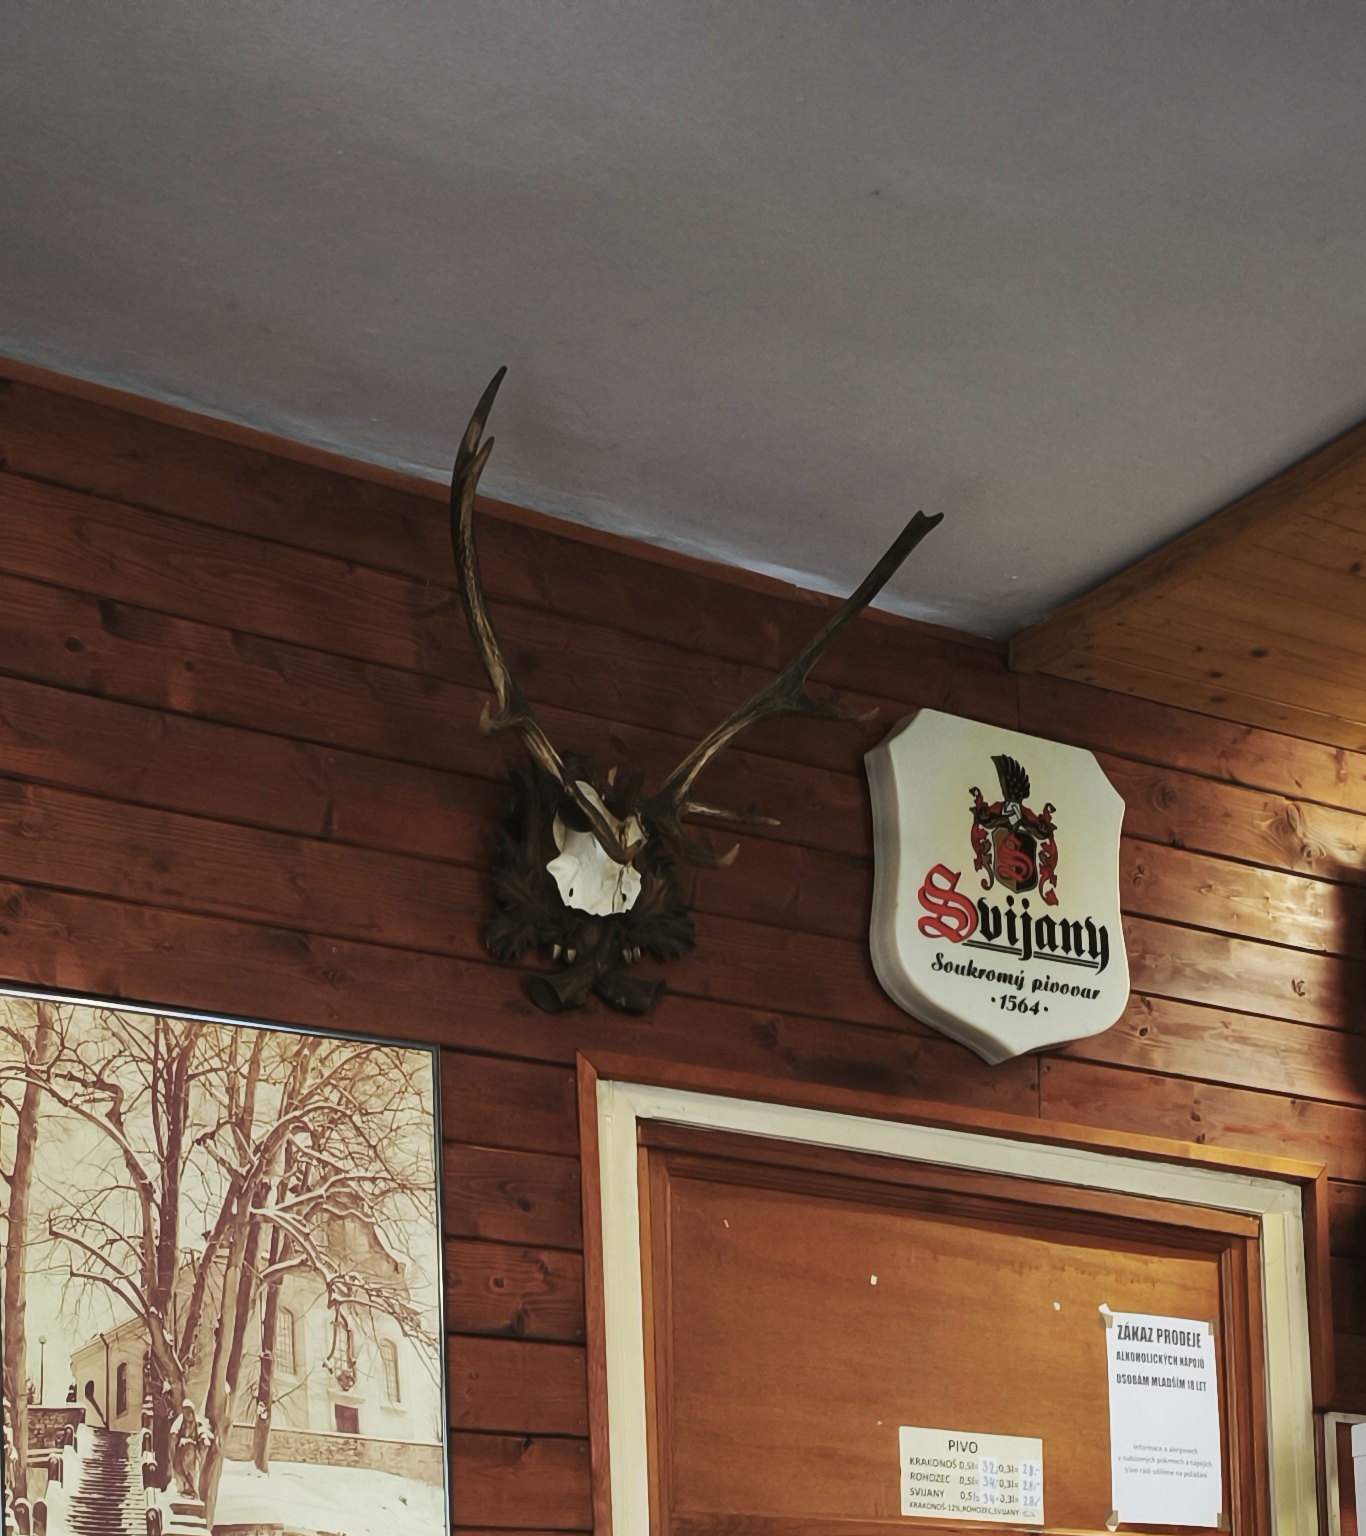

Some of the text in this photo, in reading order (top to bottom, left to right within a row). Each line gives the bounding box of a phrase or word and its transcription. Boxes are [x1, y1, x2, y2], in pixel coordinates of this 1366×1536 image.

[917, 863, 1110, 975] Svijany
[931, 952, 1101, 1000] Soukromý pivovar
[1117, 1322, 1202, 1348] ZÁKAZ PRODEJE
[1116, 1350, 1178, 1366] ALKOHOLICKÝCH
[1116, 1373, 1150, 1387] OSOBÁM
[1151, 1376, 1186, 1390] MLADŠÍM
[1196, 1381, 1207, 1392] LET
[948, 1440, 978, 1454] PIVO
[910, 1457, 958, 1469] KRAKONOŠ
[910, 1472, 951, 1484] ROHOZEC
[910, 1487, 945, 1498] SVIJANY
